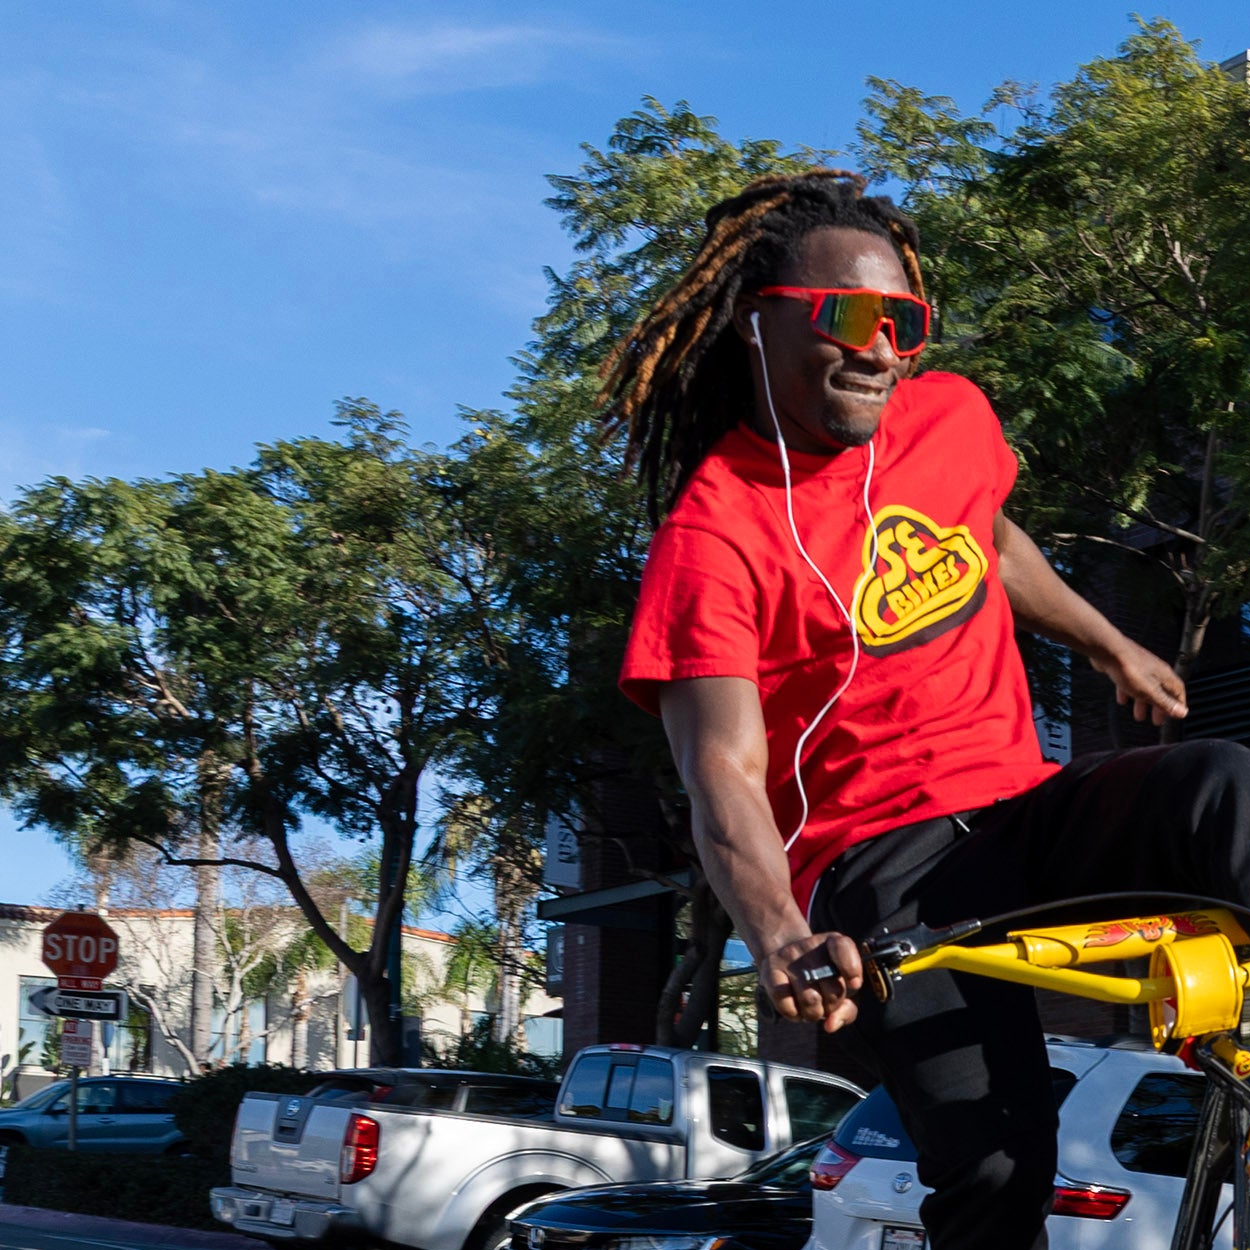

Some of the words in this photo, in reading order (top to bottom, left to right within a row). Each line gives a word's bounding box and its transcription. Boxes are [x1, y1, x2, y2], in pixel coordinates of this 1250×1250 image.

[886, 554, 961, 620] BIKES
[45, 933, 117, 964] STOP
[55, 996, 81, 1010] ONE
